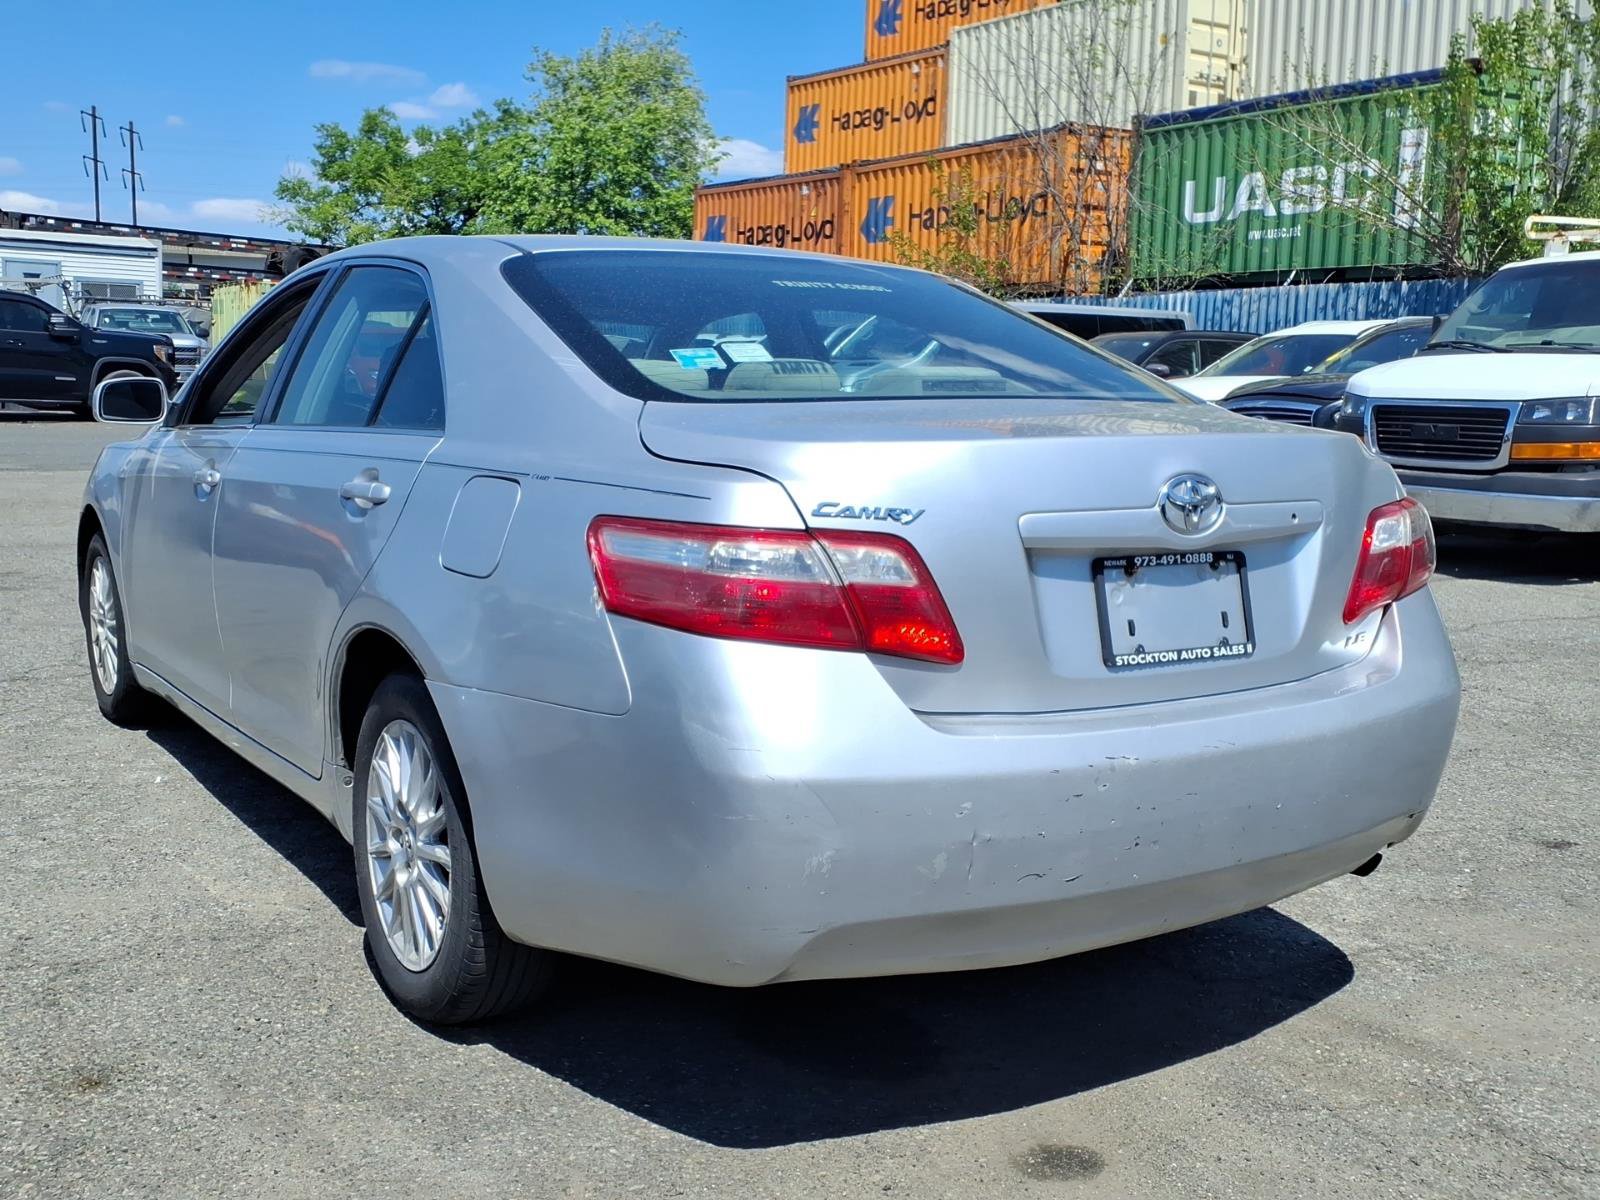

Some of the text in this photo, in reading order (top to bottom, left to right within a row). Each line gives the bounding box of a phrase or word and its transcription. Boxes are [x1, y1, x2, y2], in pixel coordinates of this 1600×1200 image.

[831, 90, 937, 135] Hapag-Lloyd
[1184, 158, 1381, 224] UASC
[736, 213, 834, 248] Hapag-Lloyd
[811, 501, 926, 526] CAMRY
[1103, 559, 1128, 568] NEWARK
[1134, 552, 1214, 567] 973-491-0888
[1115, 653, 1178, 667] STOCKTON
[1180, 648, 1211, 660] AUTO
[1213, 645, 1245, 657] SALES
